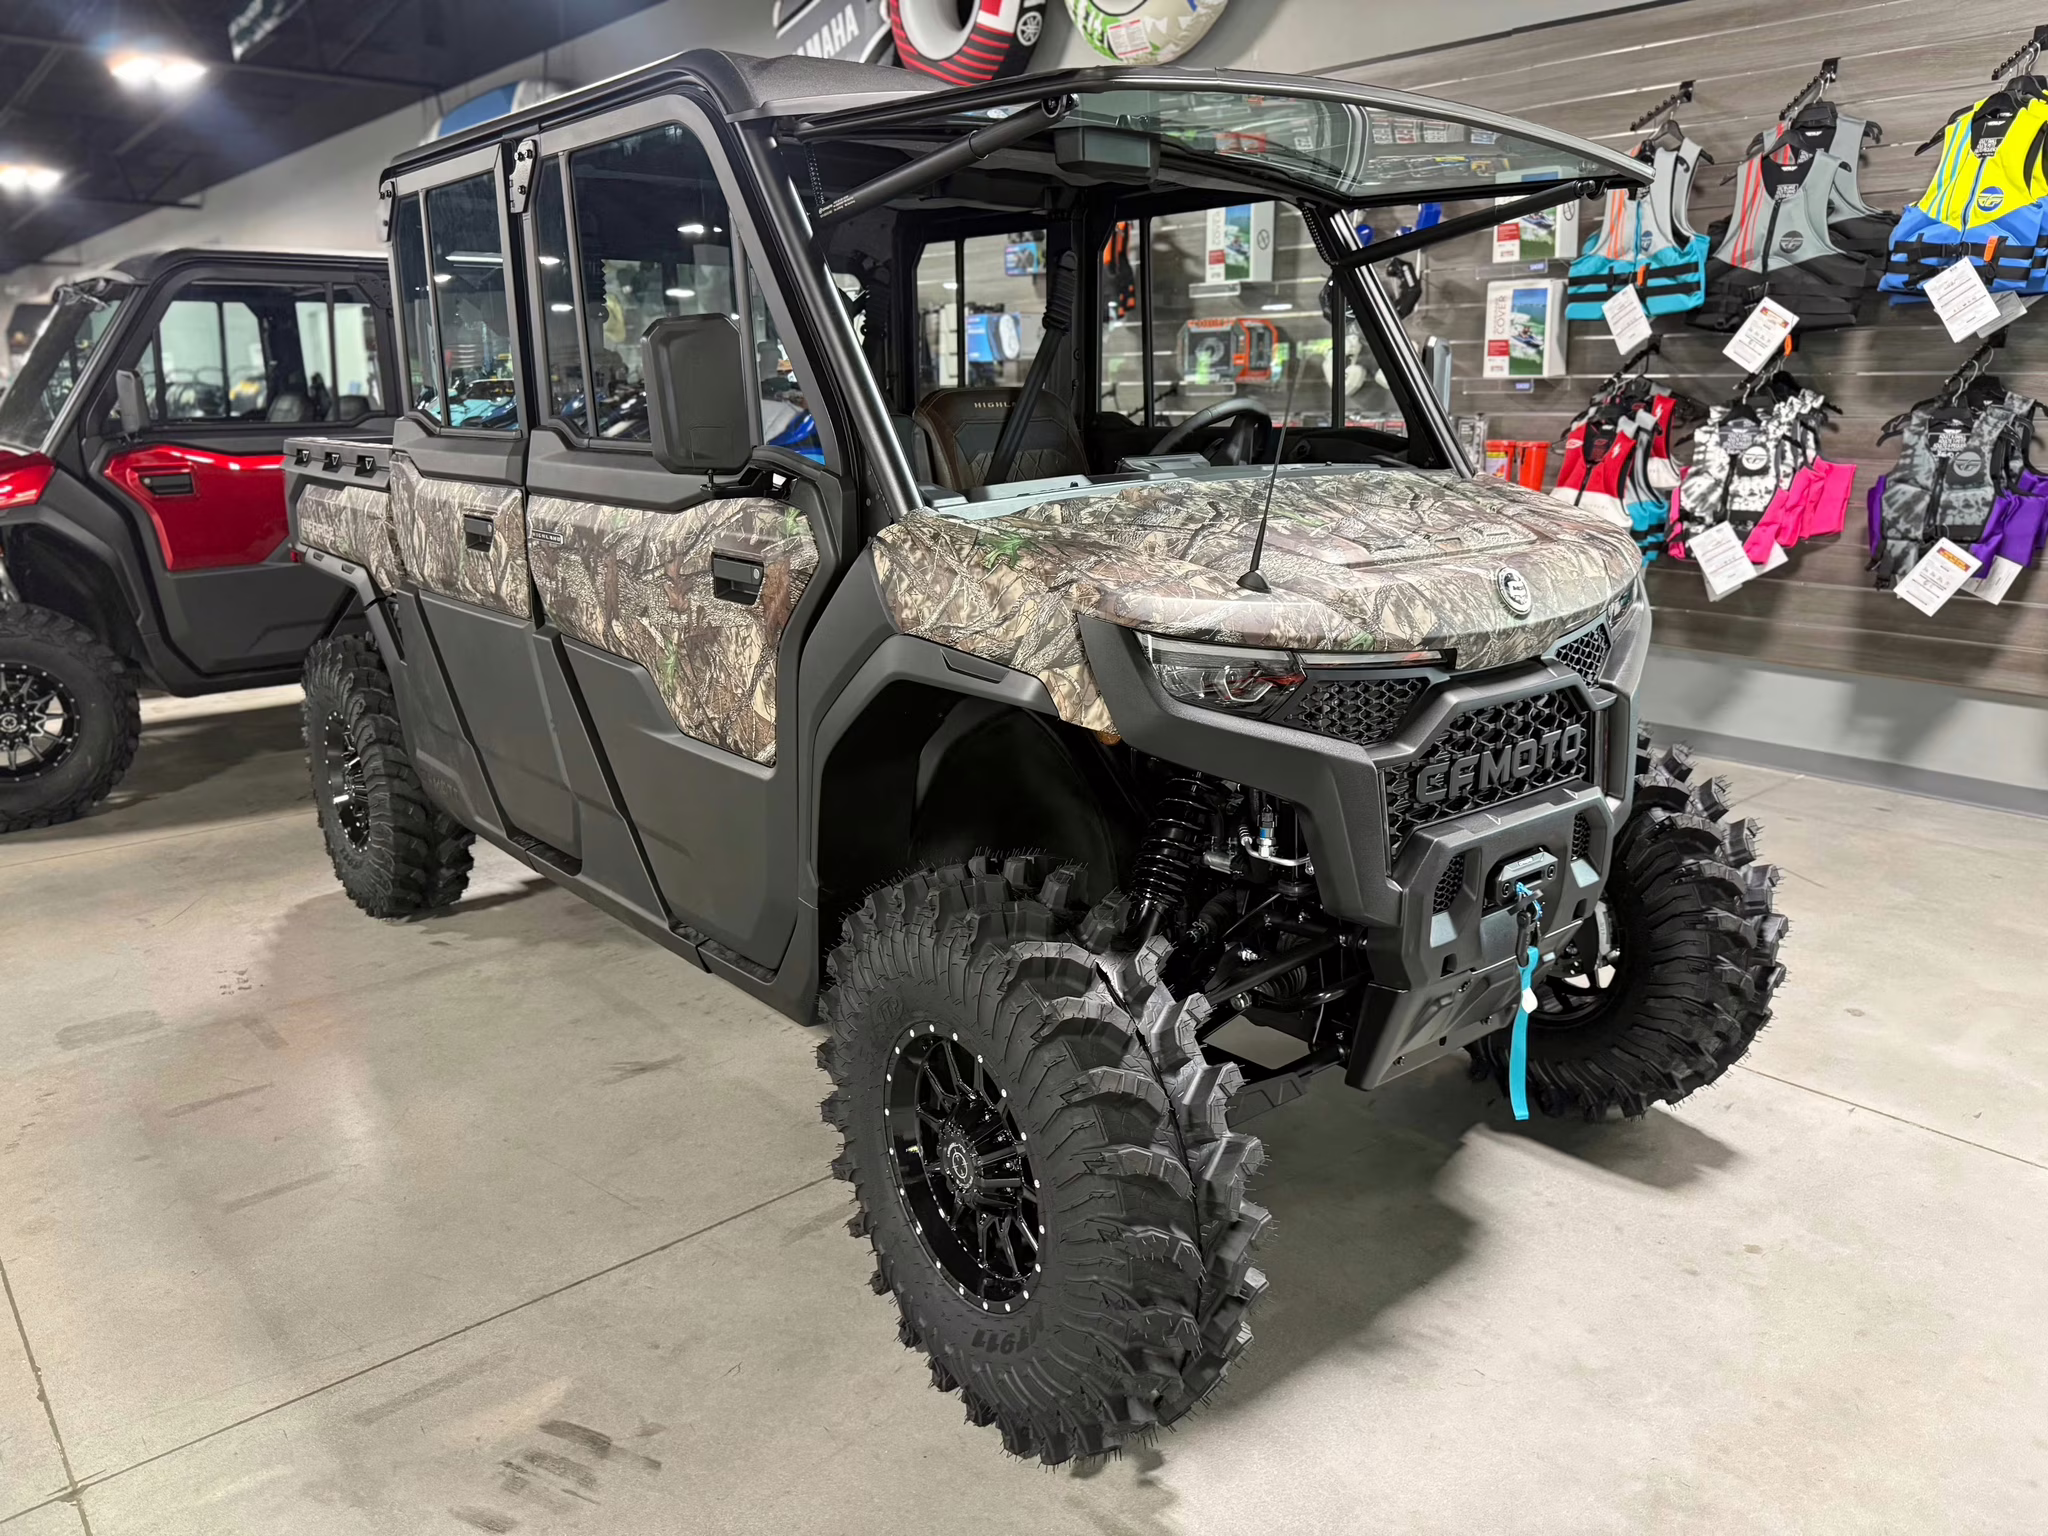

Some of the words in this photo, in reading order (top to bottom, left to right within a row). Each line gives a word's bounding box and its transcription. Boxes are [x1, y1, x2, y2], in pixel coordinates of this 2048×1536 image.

[792, 3, 860, 59] MAHA
[1496, 295, 1507, 335] COVER
[974, 401, 1017, 409] HIGHL
[1417, 724, 1582, 803] CFMOTO
